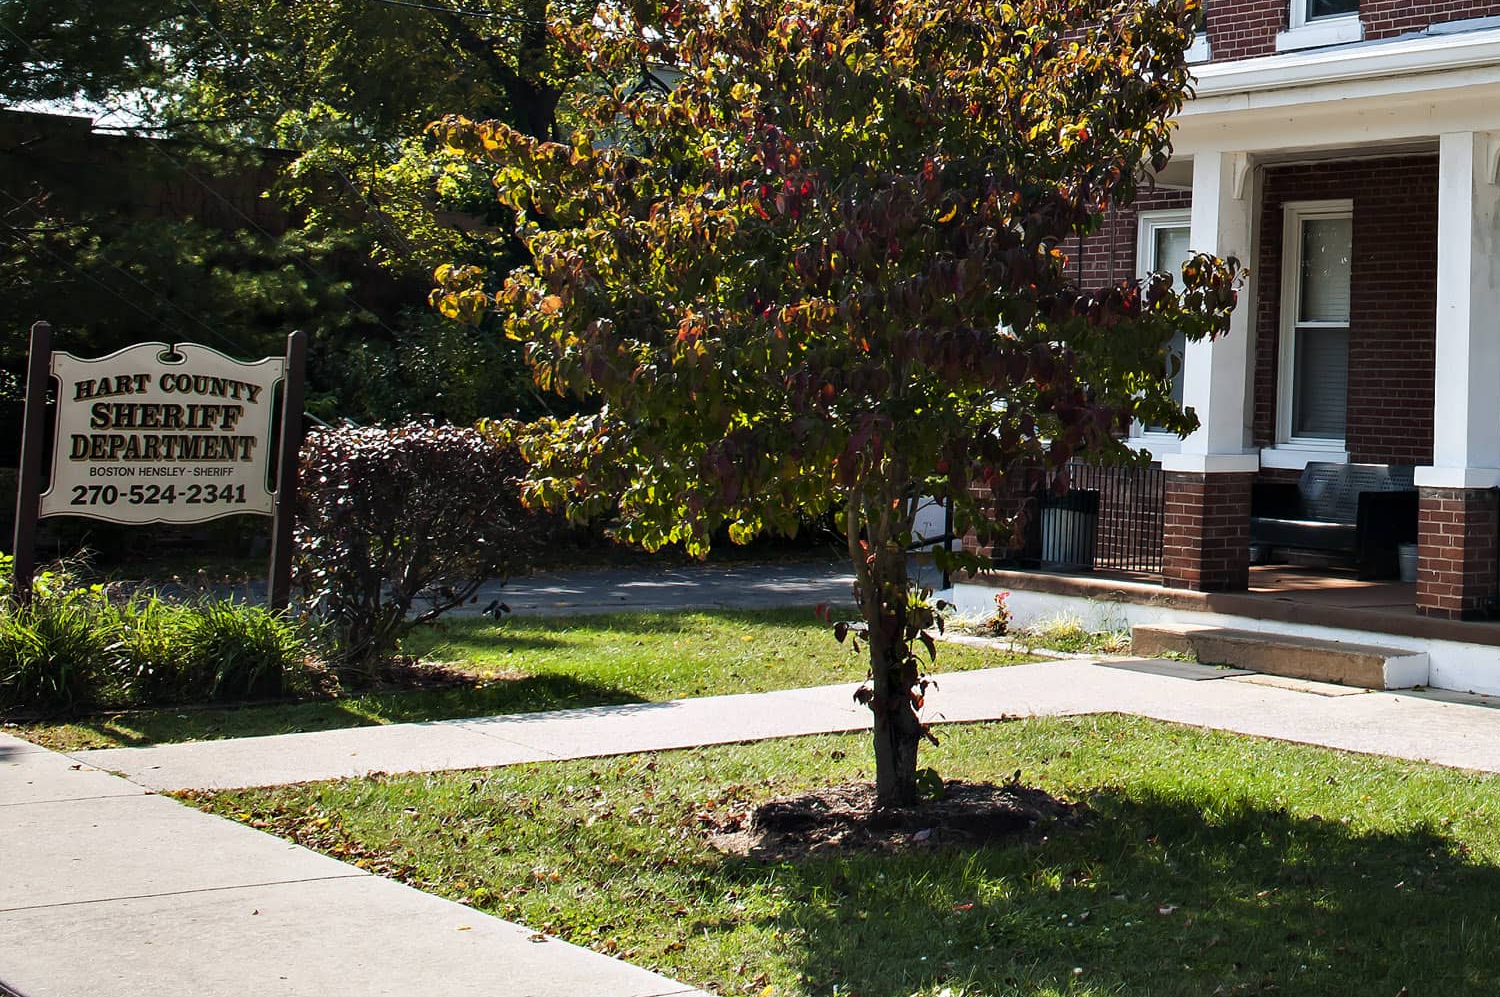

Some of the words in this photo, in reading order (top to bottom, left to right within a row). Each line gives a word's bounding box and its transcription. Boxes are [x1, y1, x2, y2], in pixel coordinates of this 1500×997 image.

[73, 374, 151, 402] HART
[159, 373, 262, 404] COUNTY
[90, 402, 244, 431] SHERIFF
[69, 434, 257, 462] DEPARTMENT
[90, 467, 135, 477] BOSTON
[70, 484, 247, 505] 270-524-2341
